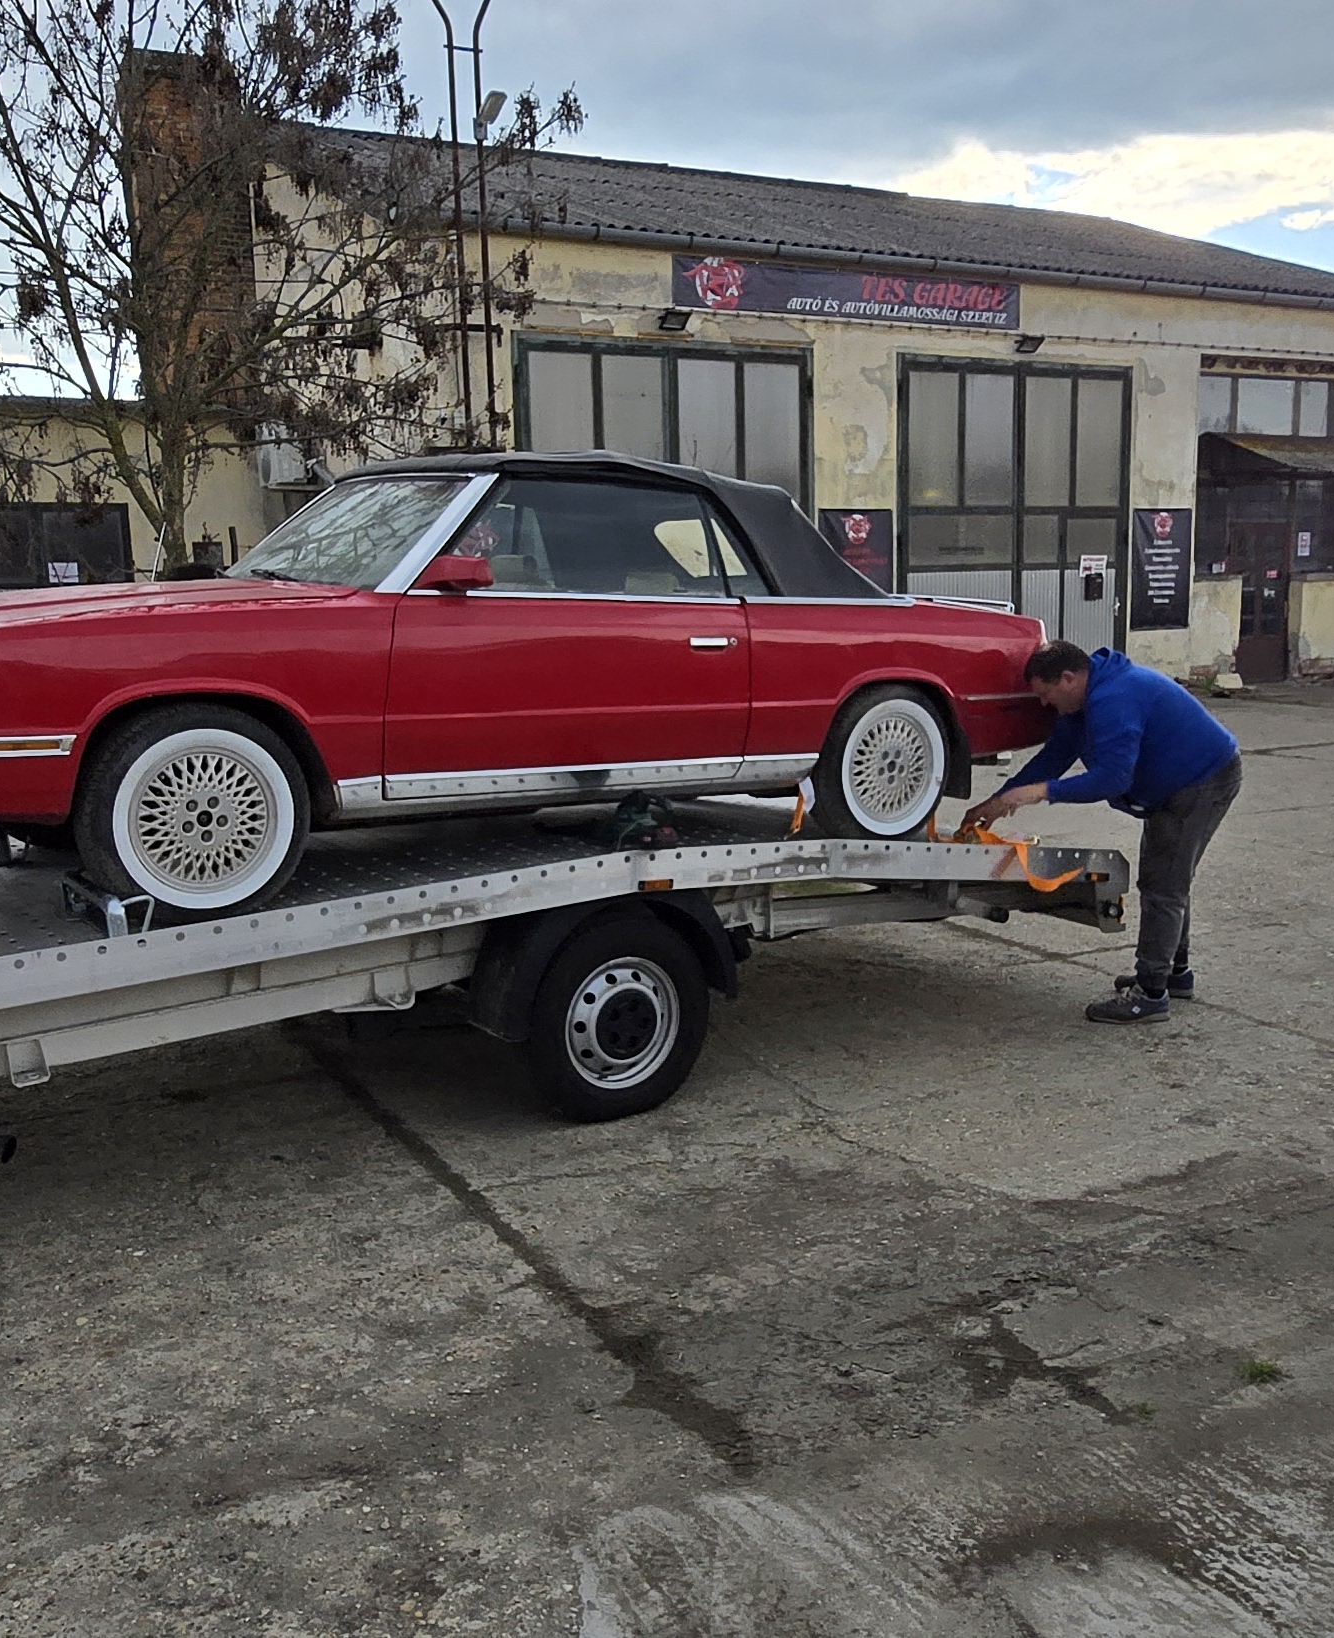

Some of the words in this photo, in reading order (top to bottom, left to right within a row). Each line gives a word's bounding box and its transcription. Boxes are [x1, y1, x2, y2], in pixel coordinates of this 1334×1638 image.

[861, 275, 907, 304] TES
[912, 280, 1007, 310] GARAGE
[786, 296, 822, 312] AUTÓ
[823, 297, 840, 313] ÉS
[841, 300, 959, 322] AUTÓVILLAMOSSÁGI
